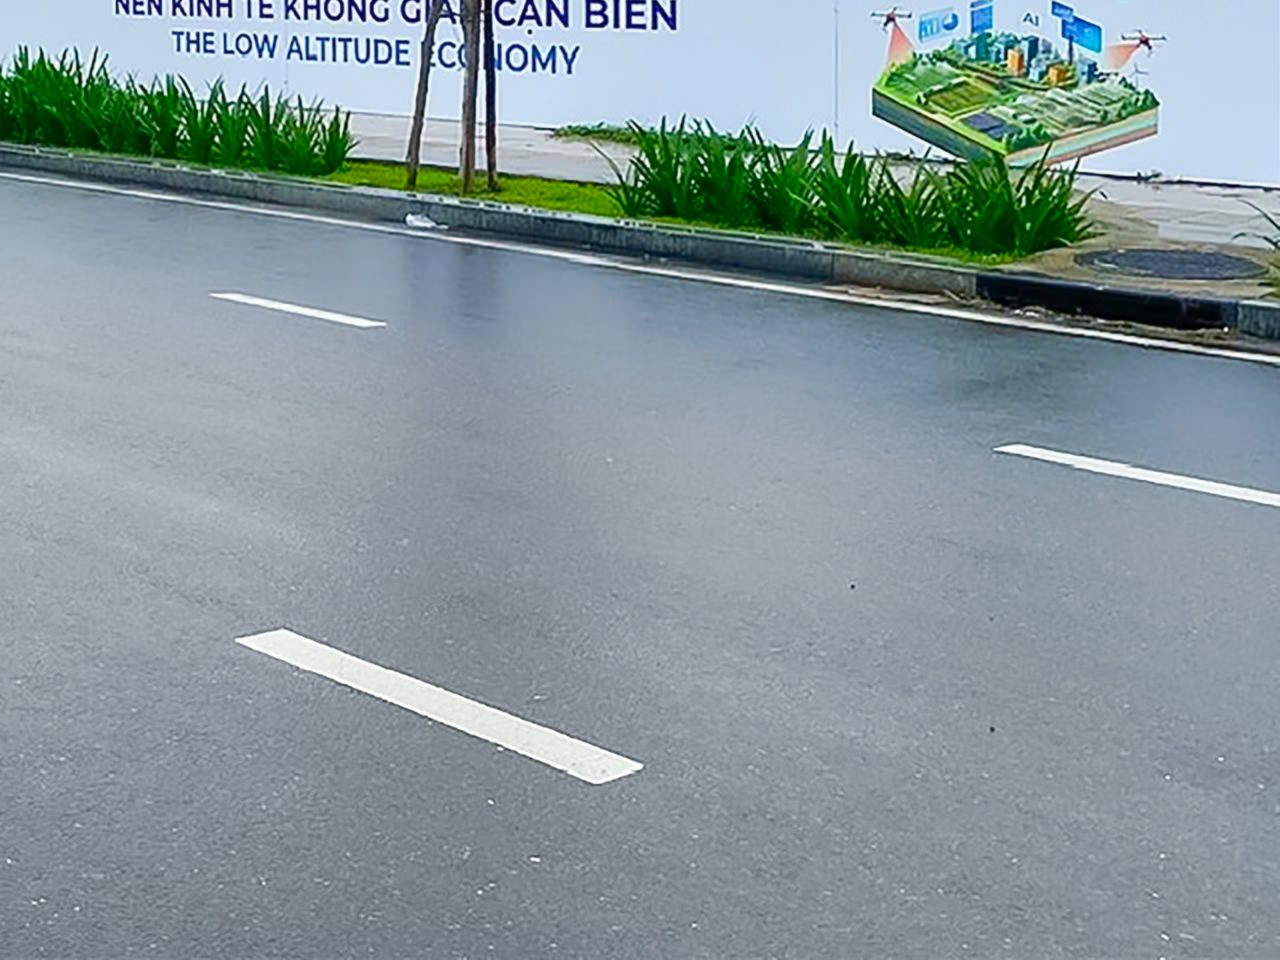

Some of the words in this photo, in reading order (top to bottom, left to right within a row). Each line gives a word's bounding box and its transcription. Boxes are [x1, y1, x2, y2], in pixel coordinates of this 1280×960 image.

[171, 30, 216, 54] THE
[223, 33, 279, 58] LOW
[287, 35, 411, 66] ALTITUDE
